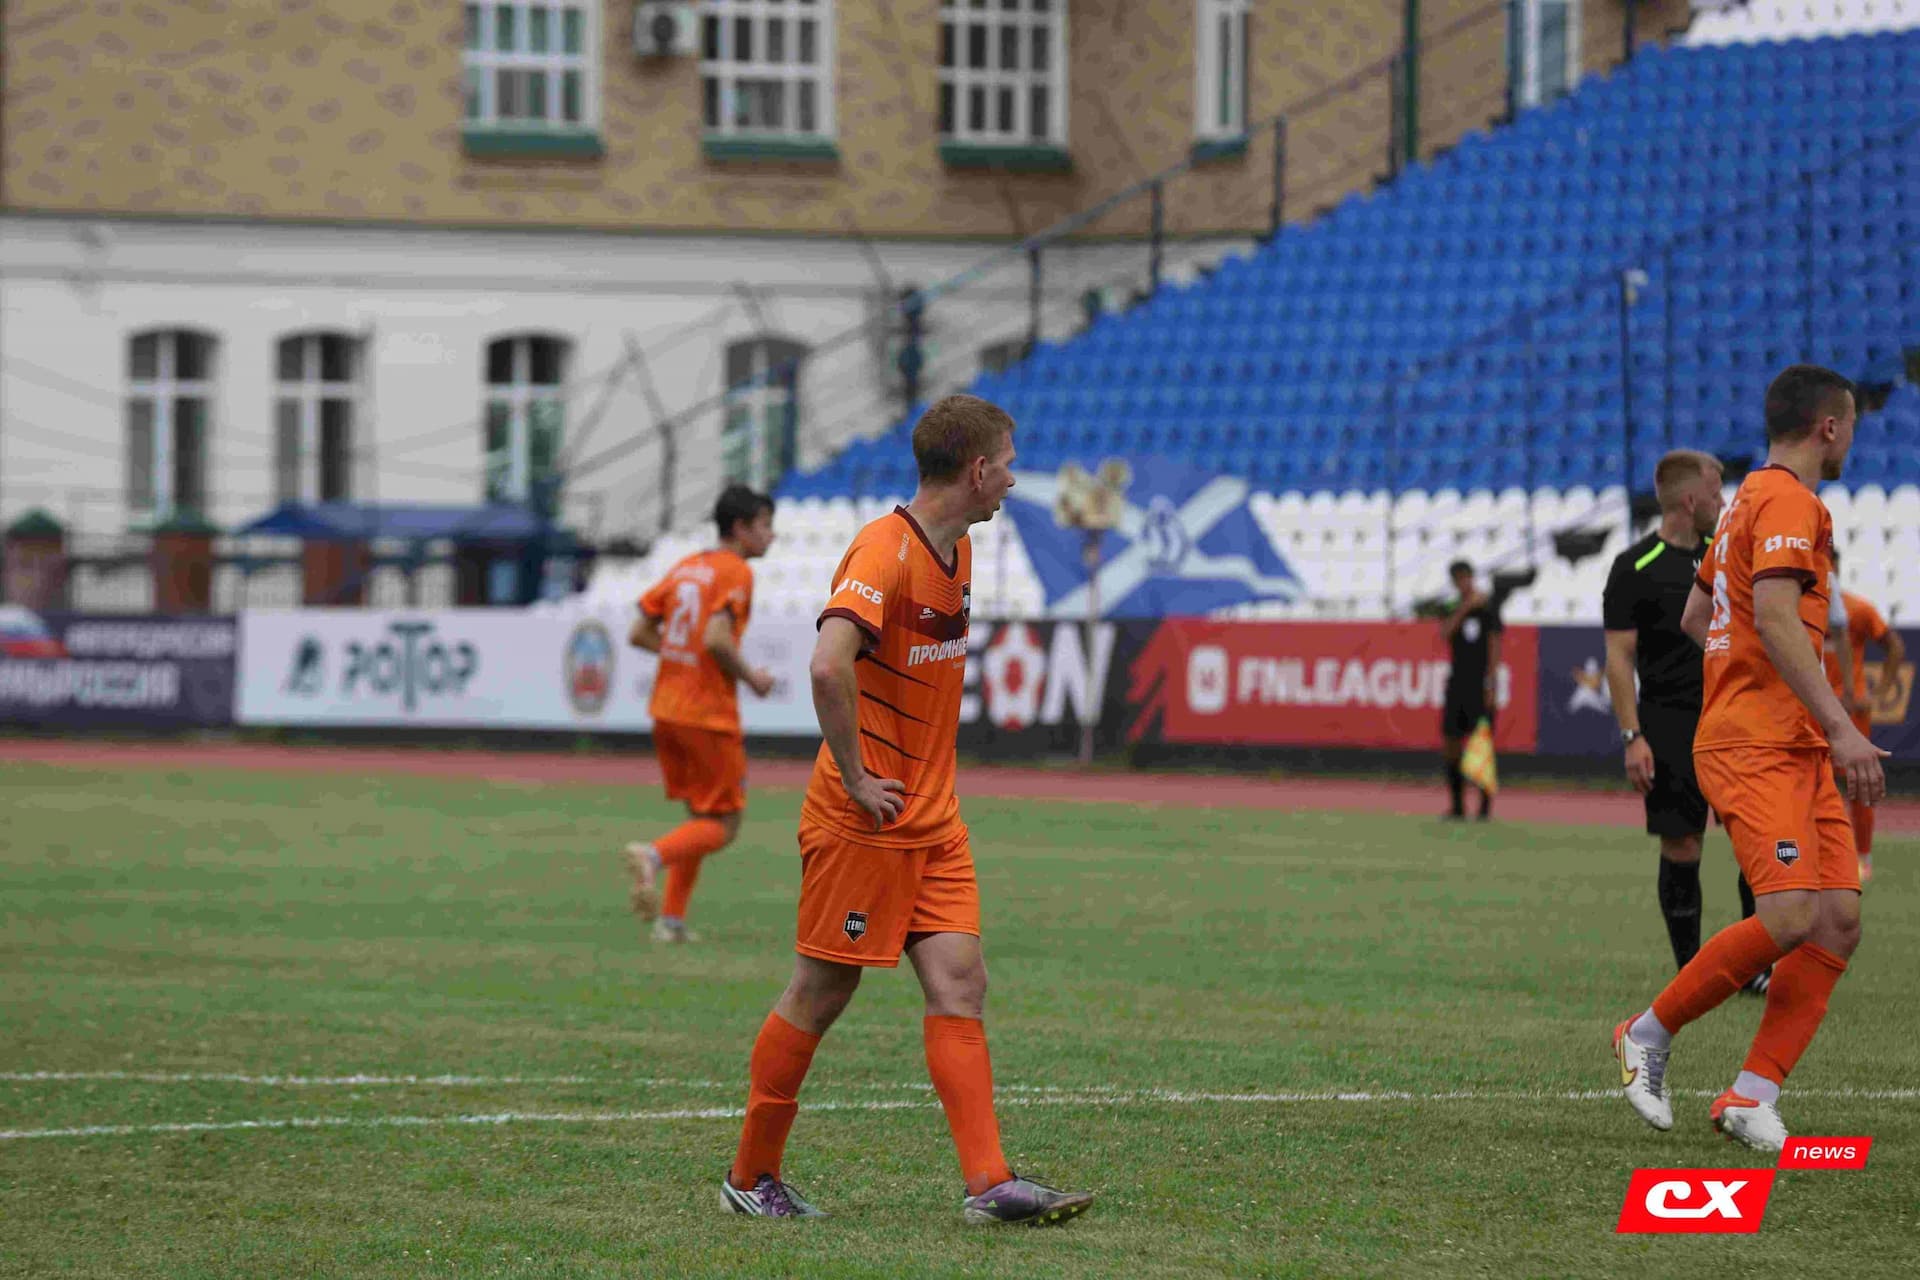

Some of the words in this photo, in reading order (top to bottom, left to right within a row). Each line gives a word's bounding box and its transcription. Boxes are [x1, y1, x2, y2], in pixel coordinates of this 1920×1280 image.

[1785, 536, 1812, 551] ПС
[849, 579, 884, 605] ПСБ
[959, 621, 1116, 727] EON
